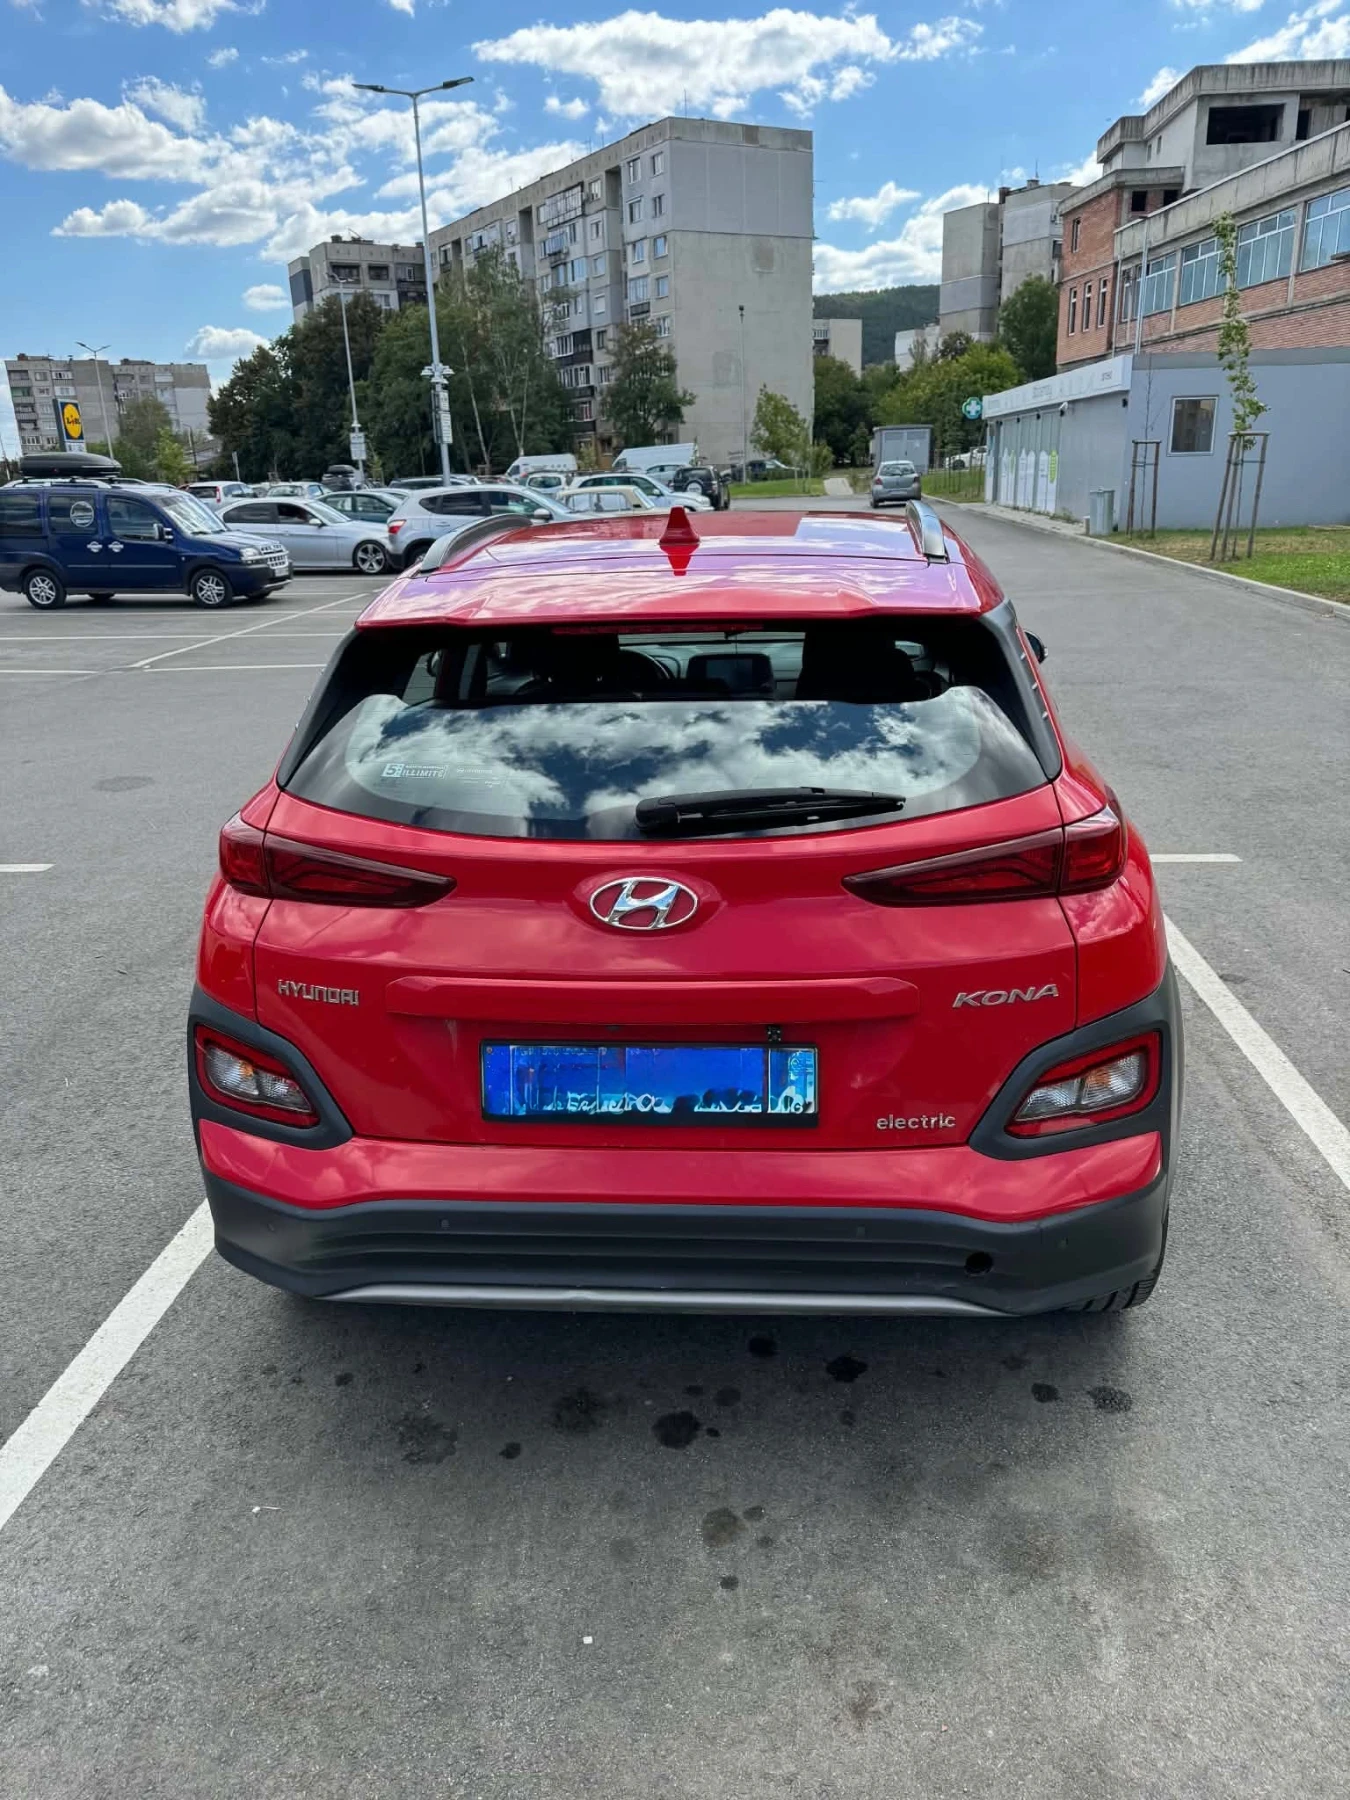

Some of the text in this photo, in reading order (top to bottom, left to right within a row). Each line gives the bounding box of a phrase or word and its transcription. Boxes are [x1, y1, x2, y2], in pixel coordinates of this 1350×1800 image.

[278, 979, 359, 1006] HYUNDAI
[952, 983, 1059, 1008] KONA
[876, 1112, 956, 1130] electric
